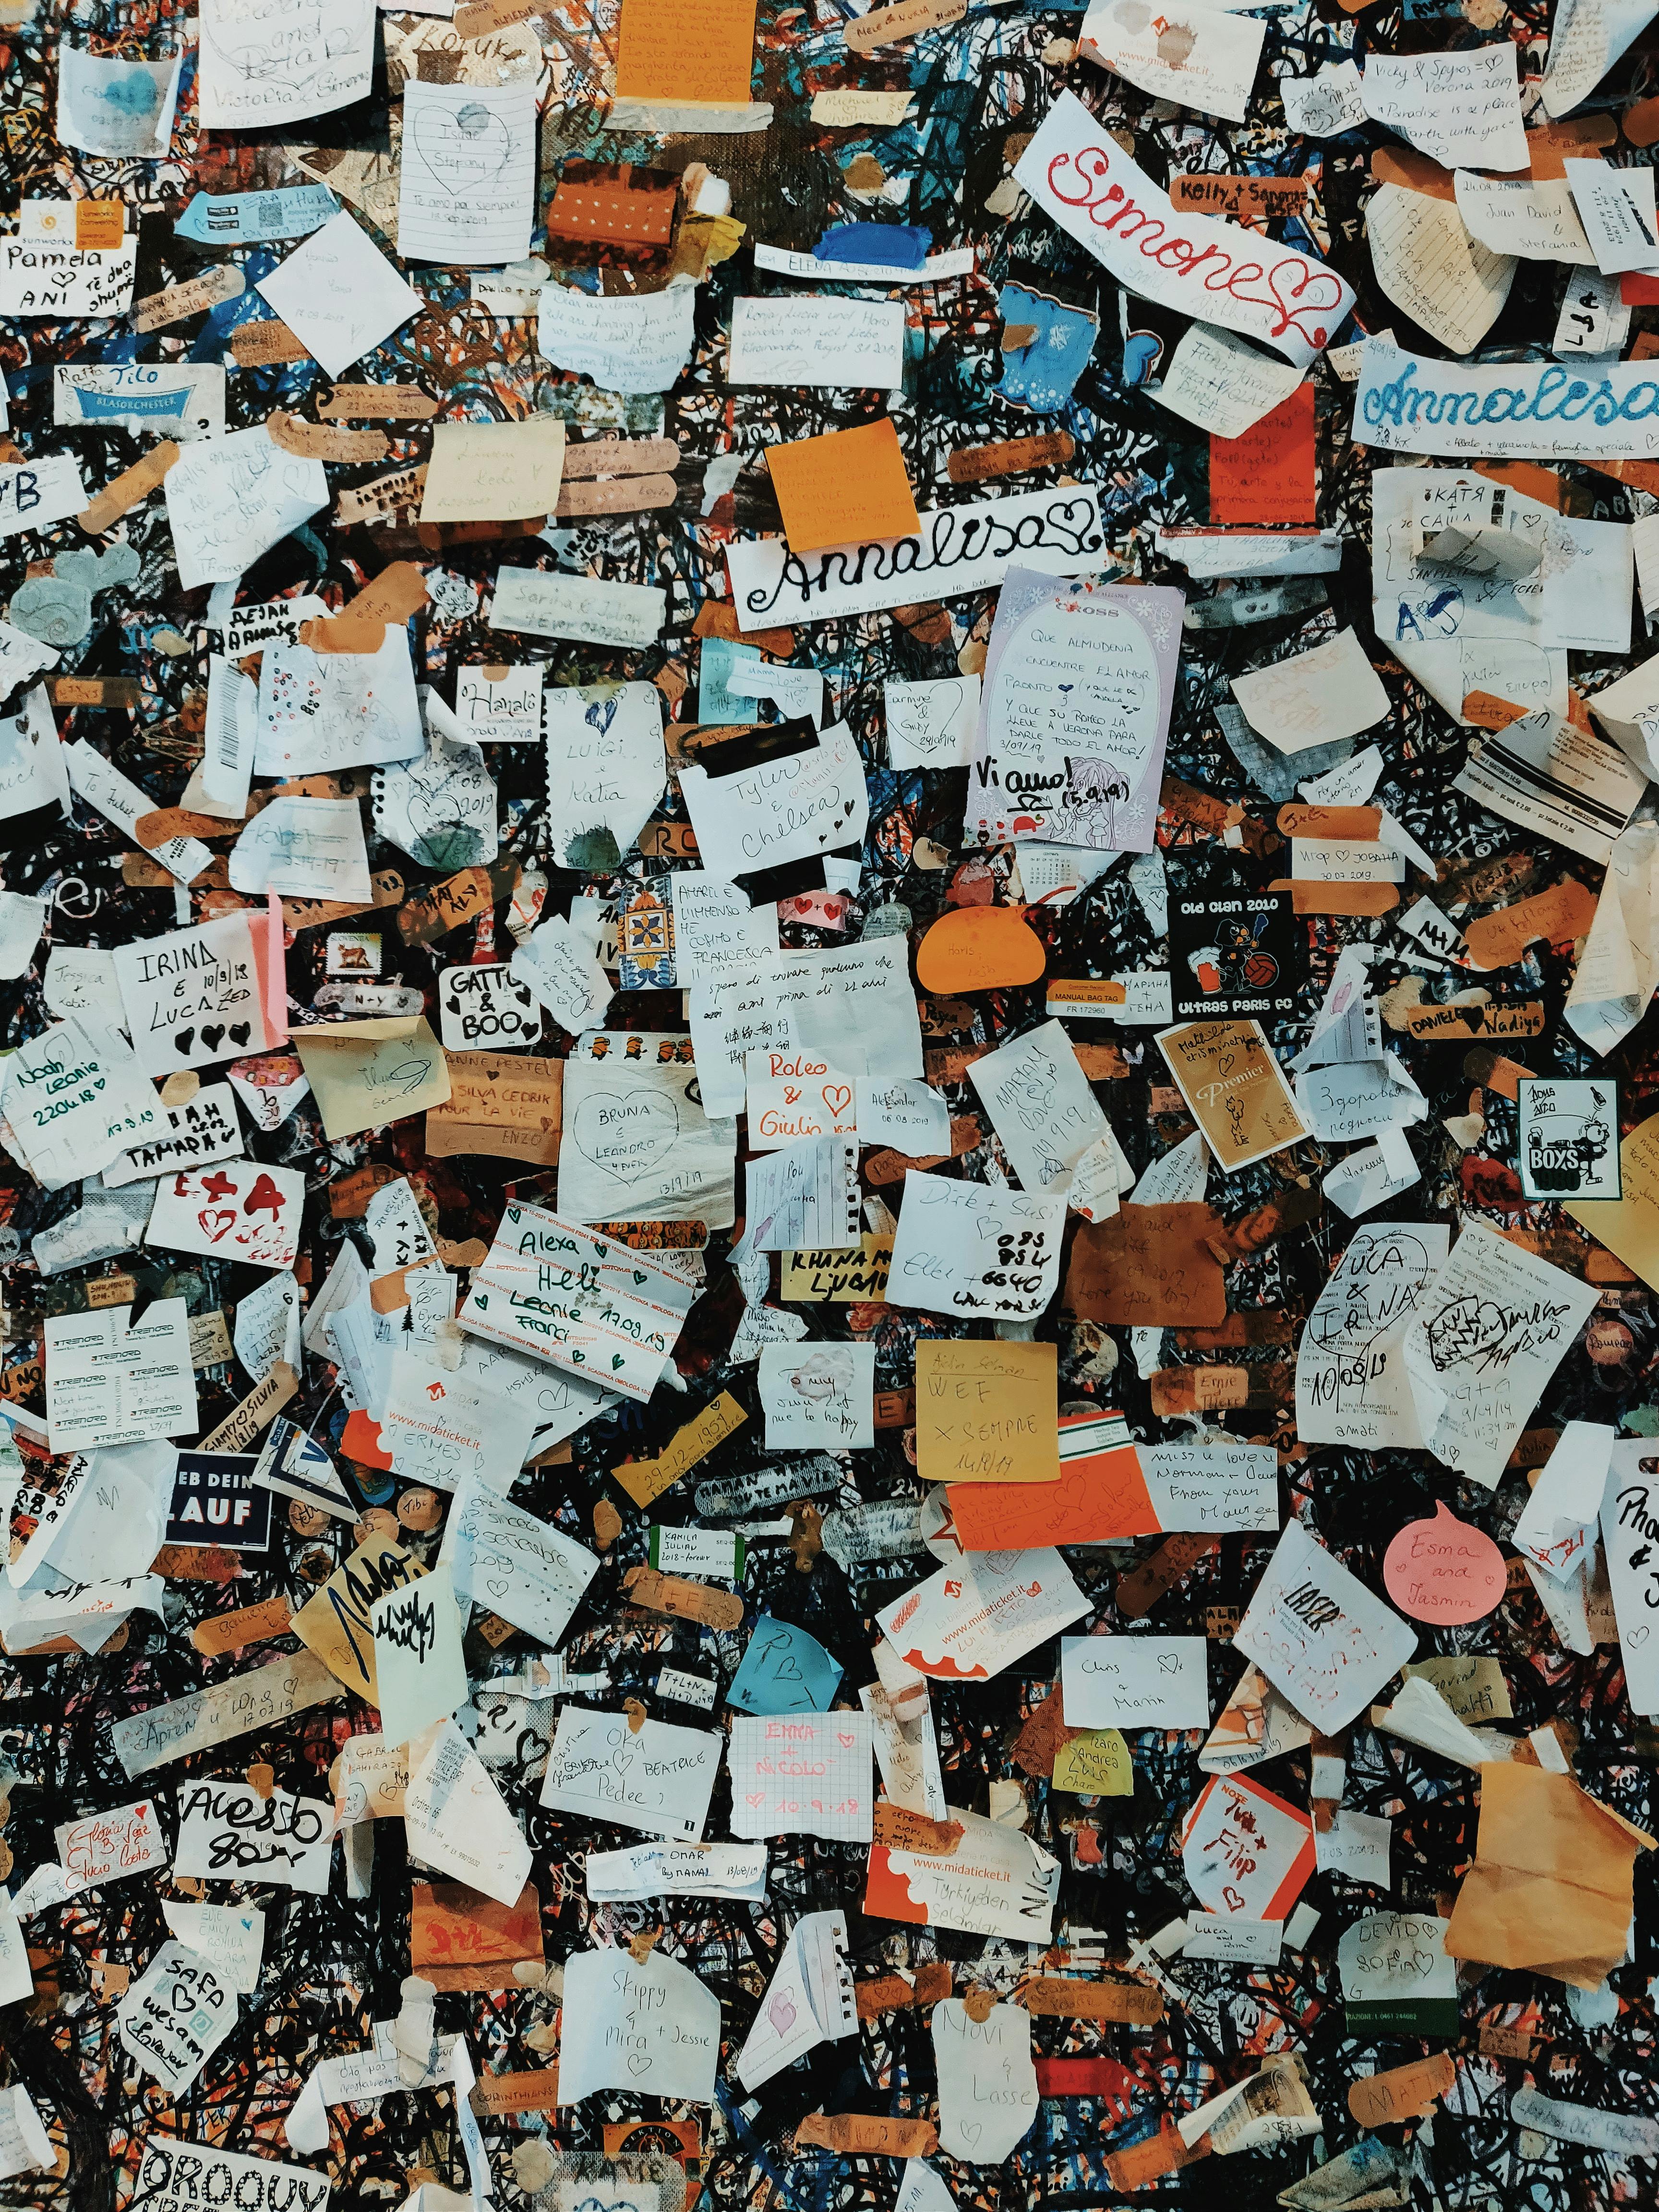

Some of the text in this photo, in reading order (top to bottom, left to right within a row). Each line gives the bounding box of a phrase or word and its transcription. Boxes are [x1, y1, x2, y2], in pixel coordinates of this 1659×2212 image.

[1377, 64, 1407, 86] Vicky
[1425, 78, 1512, 93] Verona 2019
[1482, 97, 1518, 116] place
[1450, 127, 1476, 138] with
[434, 152, 486, 174] Stefany
[1488, 204, 1561, 218] Juan David
[1047, 147, 1263, 302] Simone
[1520, 238, 1581, 250] Stefania
[8, 246, 103, 269] Pamela
[788, 255, 831, 274] ELENA
[20, 291, 66, 308] ANI
[110, 365, 157, 385] Tilo
[97, 397, 173, 409] BLASORCHESTER
[1435, 487, 1485, 502] КАТЯ
[747, 512, 1046, 613] Annalisa
[1031, 629, 1132, 652] QUE ALMUDENA
[1026, 658, 1084, 672] ENCUENTRE
[1117, 668, 1150, 679] AMOR
[1005, 674, 1052, 692] PRONTO
[1019, 704, 1044, 715] QUE
[1049, 708, 1065, 720] SU
[1112, 720, 1127, 729] LA
[1010, 729, 1042, 740] DARLE
[1056, 737, 1081, 746] TODO
[1064, 724, 1103, 736] VERONA
[1109, 730, 1136, 741] PARA
[85, 773, 100, 790] To
[976, 756, 999, 788] Vi
[569, 780, 627, 804] Katia
[743, 784, 842, 857] Chelsea
[1247, 899, 1278, 911] 2010
[137, 940, 217, 983] IRINA
[692, 947, 773, 964] FRANCESCA
[55, 965, 104, 984] Jessica
[1123, 978, 1169, 990] МАРИНА
[174, 979, 185, 997] E
[1055, 993, 1086, 1002] MANUAL
[1104, 994, 1118, 1002] TAG
[480, 993, 495, 1012] &
[1275, 998, 1292, 1010] FC
[150, 996, 213, 1031] LUCA
[1412, 1008, 1539, 1035] DANIELE Nadiya
[462, 1011, 522, 1039] BOO
[17, 1059, 64, 1088] Noah
[784, 1086, 802, 1104] &
[1196, 1065, 1264, 1107] Premier
[502, 1090, 550, 1104] CEDRIK
[483, 1106, 499, 1117] LA
[599, 1106, 649, 1125] BRUNA
[912, 1117, 929, 1125] 2019
[503, 1130, 542, 1146] ENZO
[124, 1133, 216, 1167] TAMARA
[596, 1140, 654, 1159] LEANDRO
[621, 1160, 648, 1172] EVER
[1532, 1150, 1578, 1170] BOYS
[1533, 1170, 1580, 1190] 1980
[548, 1218, 575, 1233] MITSUBISHI
[519, 1231, 579, 1255] Alexa
[792, 1250, 867, 1271] KHANA
[1333, 1247, 1404, 1282] LUCA
[539, 1262, 601, 1292] Heli
[510, 1290, 585, 1323] Leonie
[624, 1293, 648, 1306] SCADENZA
[131, 1325, 173, 1334] TRENORD
[59, 1335, 104, 1347] TRENORD
[98, 1350, 141, 1362] TRENORD
[60, 1375, 106, 1385] TRENORD
[136, 1365, 179, 1376] TRENORD
[247, 1379, 278, 1417] SILVIA
[138, 1405, 182, 1417] TRENORD
[390, 1413, 480, 1452] www.midaticket.it
[1335, 1423, 1377, 1437] amati
[405, 1432, 461, 1462] ERMES
[1227, 1453, 1257, 1463] love
[665, 1531, 697, 1542] KAMILA
[1410, 1531, 1483, 1559] Esma
[665, 1542, 697, 1551] JULIAN
[1432, 1566, 1473, 1578] and
[1408, 1583, 1472, 1607] Jasmin
[942, 1580, 1026, 1644] www.midaticket.it
[766, 1723, 816, 1741] EMMA
[643, 1751, 705, 1776] BEATRICE
[1078, 1748, 1118, 1768] Andrea
[426, 1777, 440, 1787] RESTO
[671, 1851, 704, 1860] OMAR
[914, 1859, 1010, 1882] www.midaticket.it
[1195, 1923, 1227, 1934] Luca
[215, 1951, 247, 1964] LARA
[613, 1972, 665, 2010] Skippy
[606, 2026, 709, 2049] Mira Jessie
[974, 2074, 1033, 2106] Lasse
[625, 2124, 681, 2149] SEKTION
